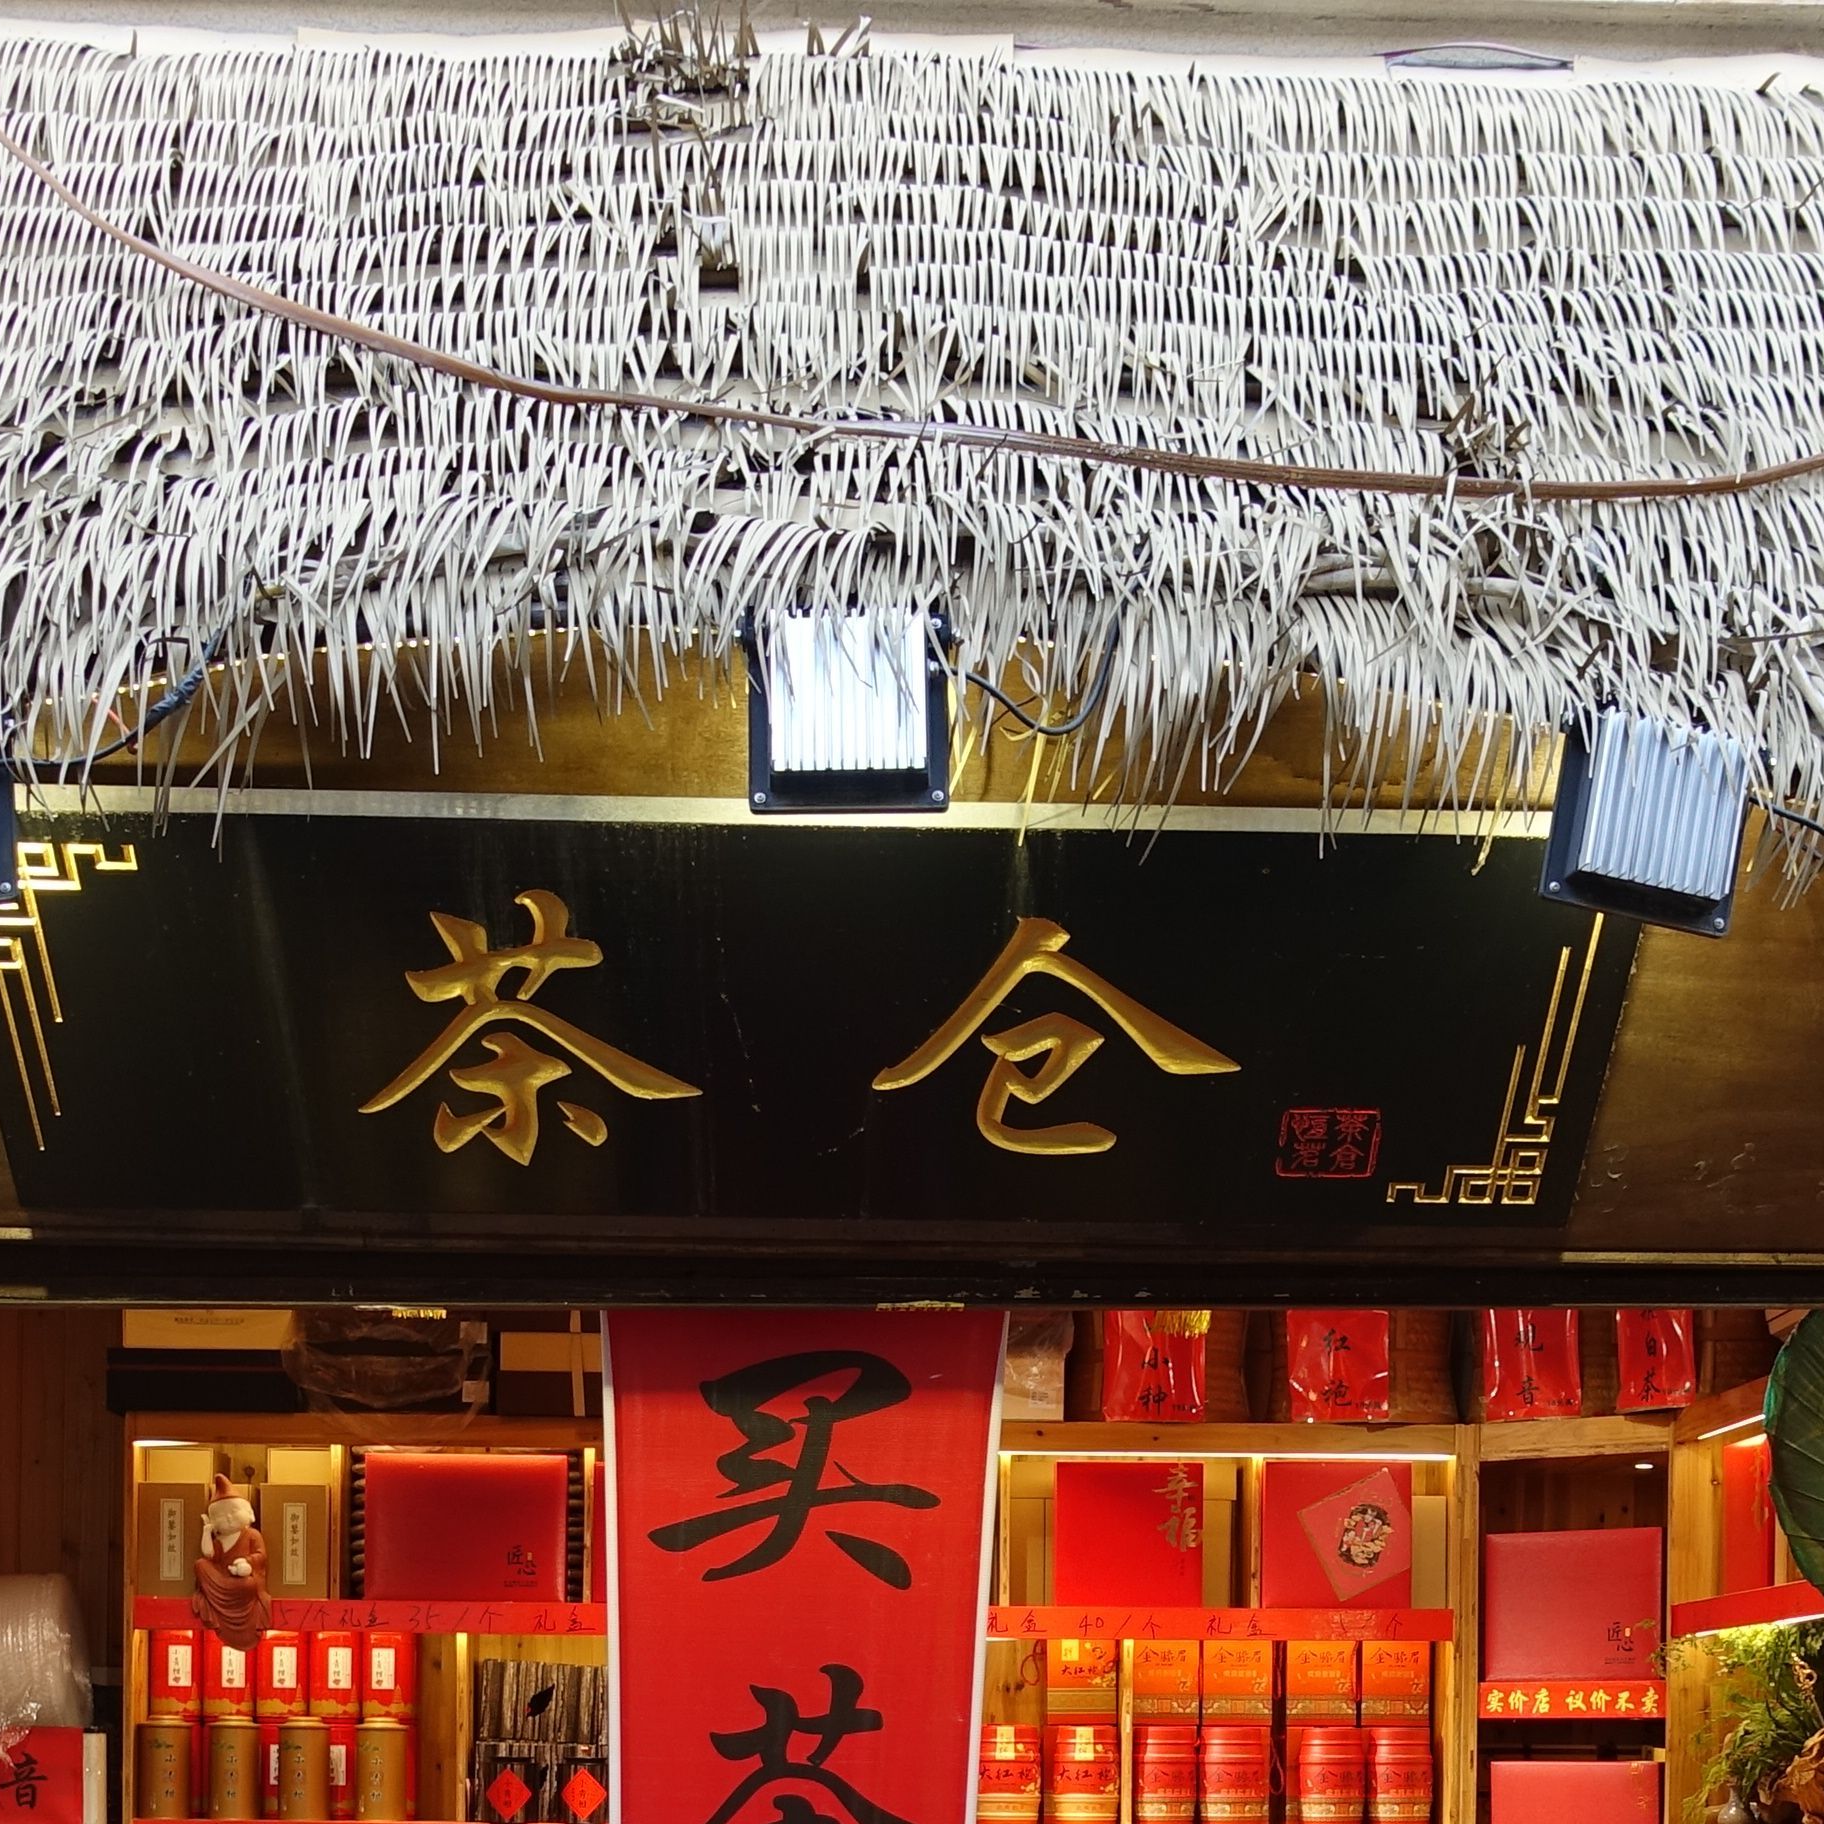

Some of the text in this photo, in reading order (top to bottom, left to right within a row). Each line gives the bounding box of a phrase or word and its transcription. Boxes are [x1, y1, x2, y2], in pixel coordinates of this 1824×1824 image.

[358, 888, 1242, 1168] 茶仓
[1487, 1689, 1658, 1714] 实价店 议价不卖
